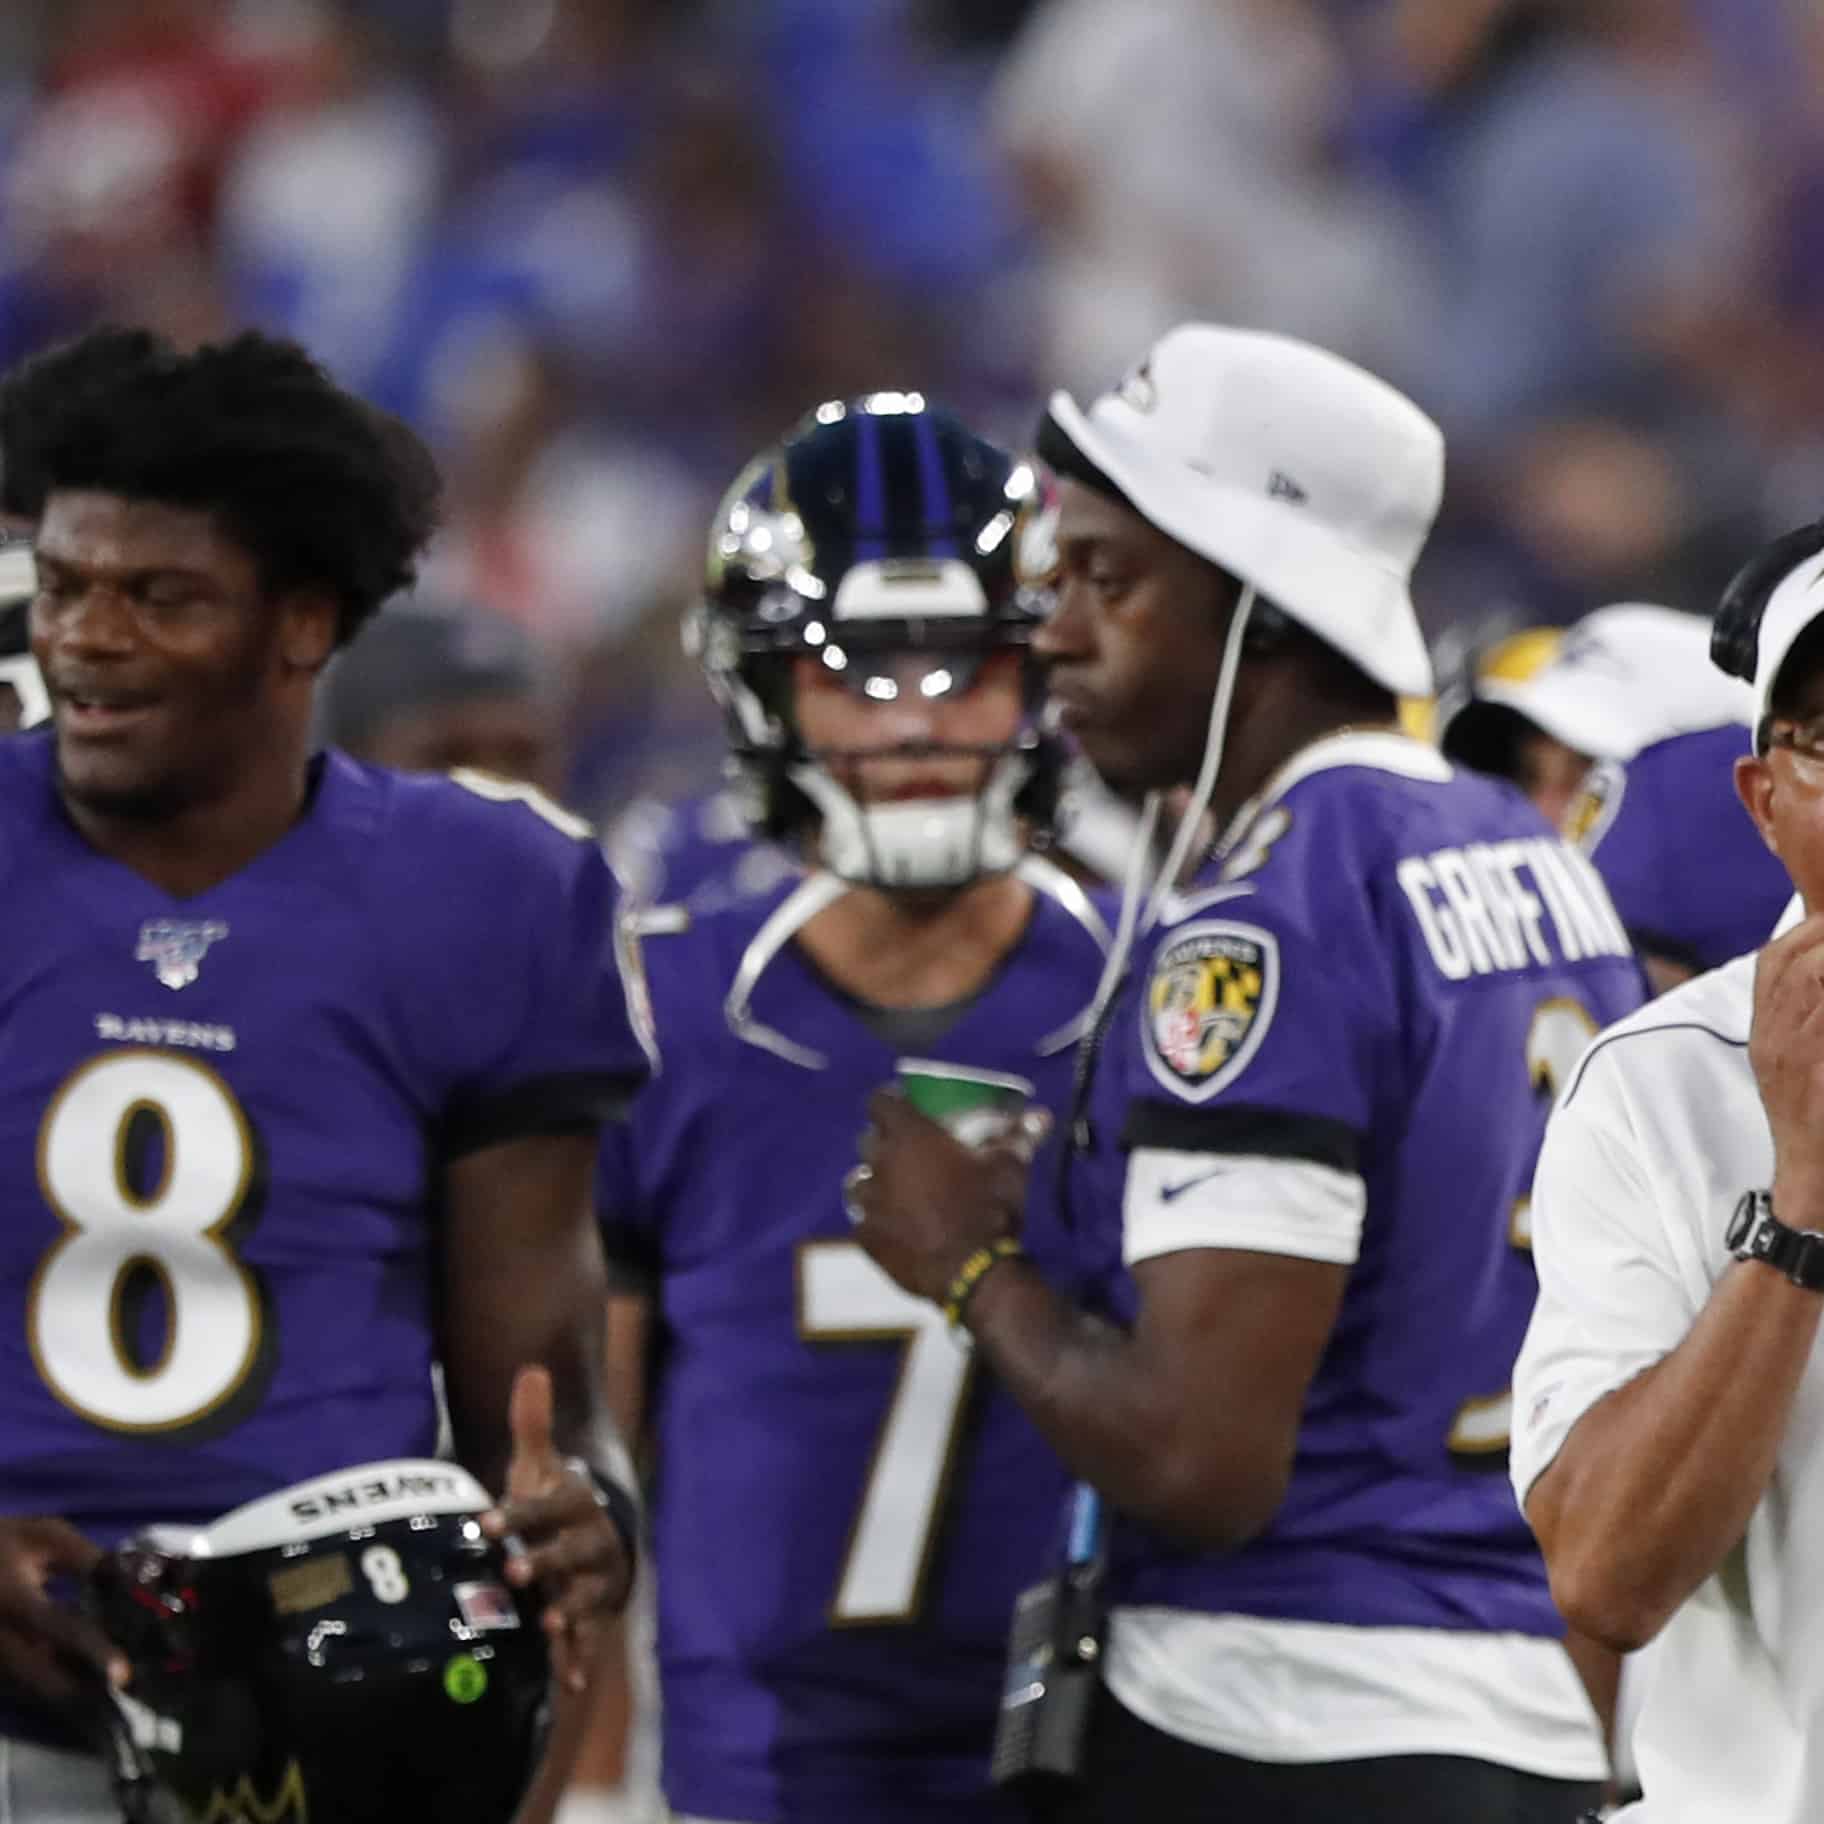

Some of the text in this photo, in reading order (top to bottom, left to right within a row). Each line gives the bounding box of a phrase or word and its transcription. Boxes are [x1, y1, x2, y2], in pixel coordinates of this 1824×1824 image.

[95, 1013, 236, 1052] RAVENS
[27, 1046, 262, 1432] 8
[796, 1239, 974, 1628] 7
[361, 1546, 408, 1605] 8
